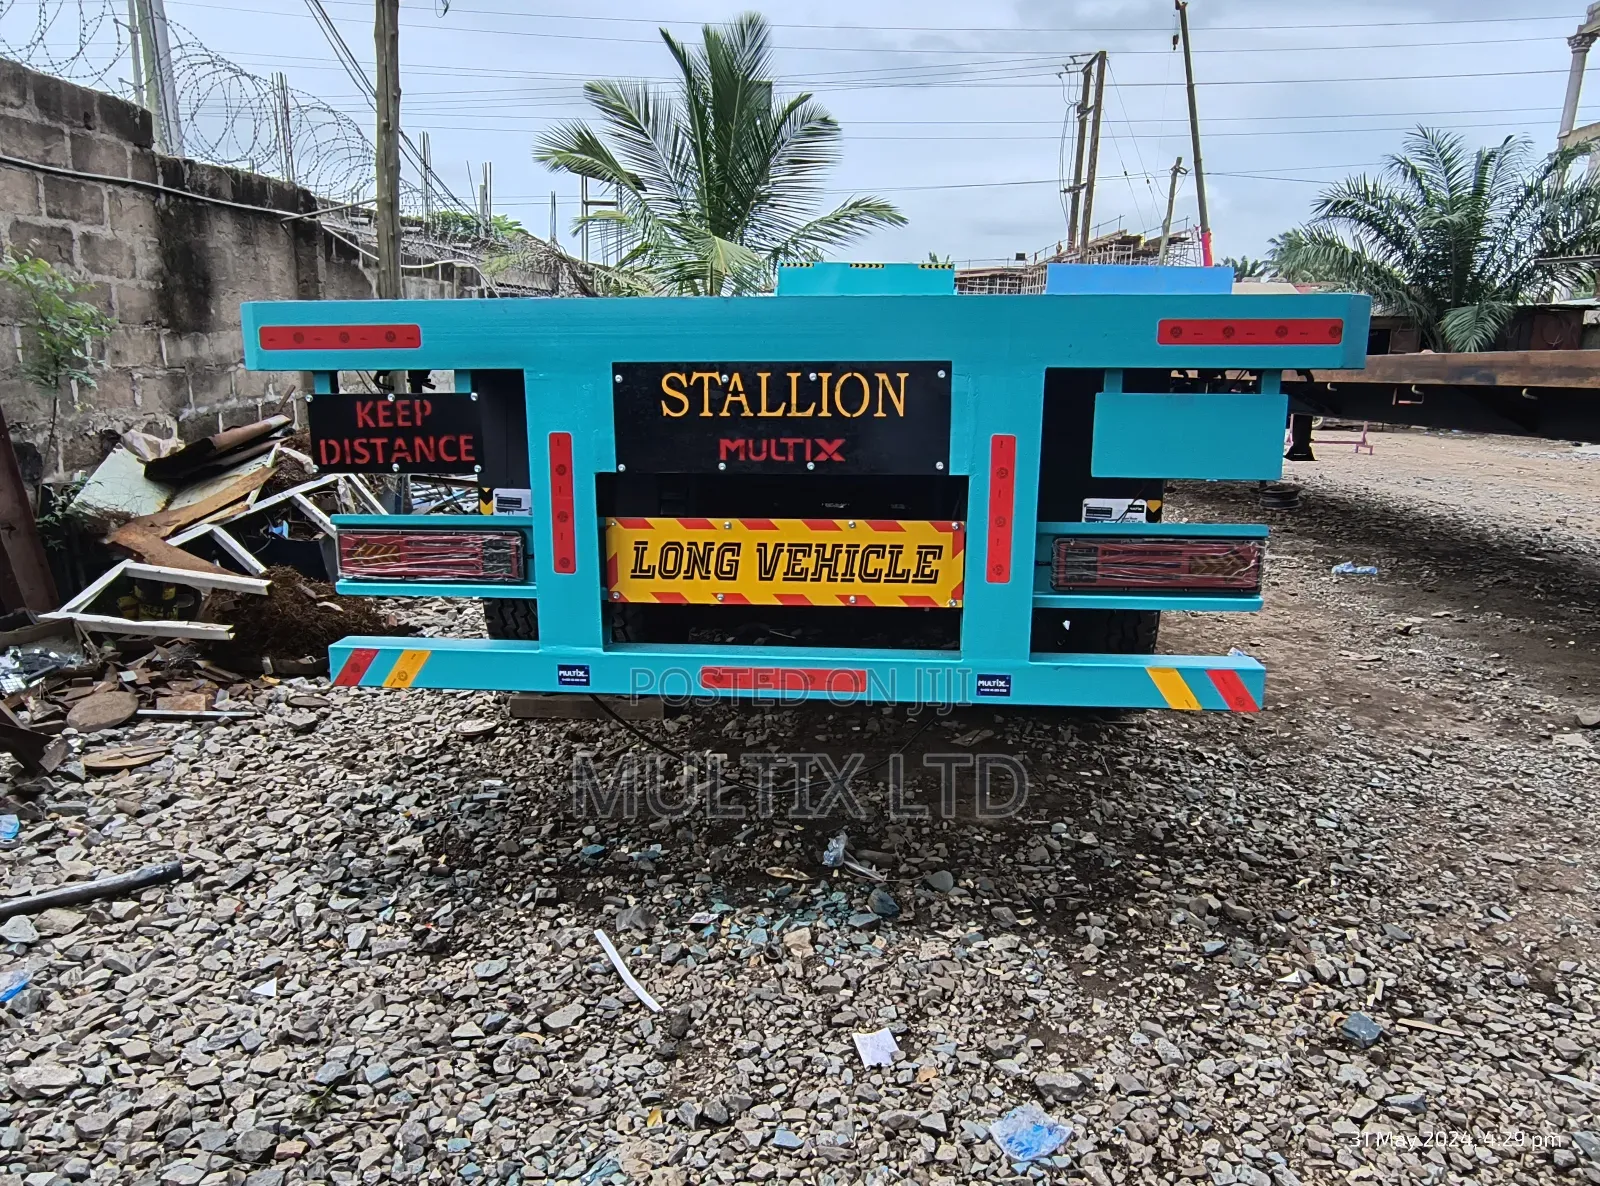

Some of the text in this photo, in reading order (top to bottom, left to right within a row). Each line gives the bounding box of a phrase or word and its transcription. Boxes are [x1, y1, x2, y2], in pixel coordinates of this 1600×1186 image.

[661, 372, 910, 418] STALLION
[356, 399, 433, 429] KEEP
[319, 434, 476, 466] DISTANCE
[719, 437, 846, 462] MULTIX
[630, 540, 944, 584] LONG VEHICLE
